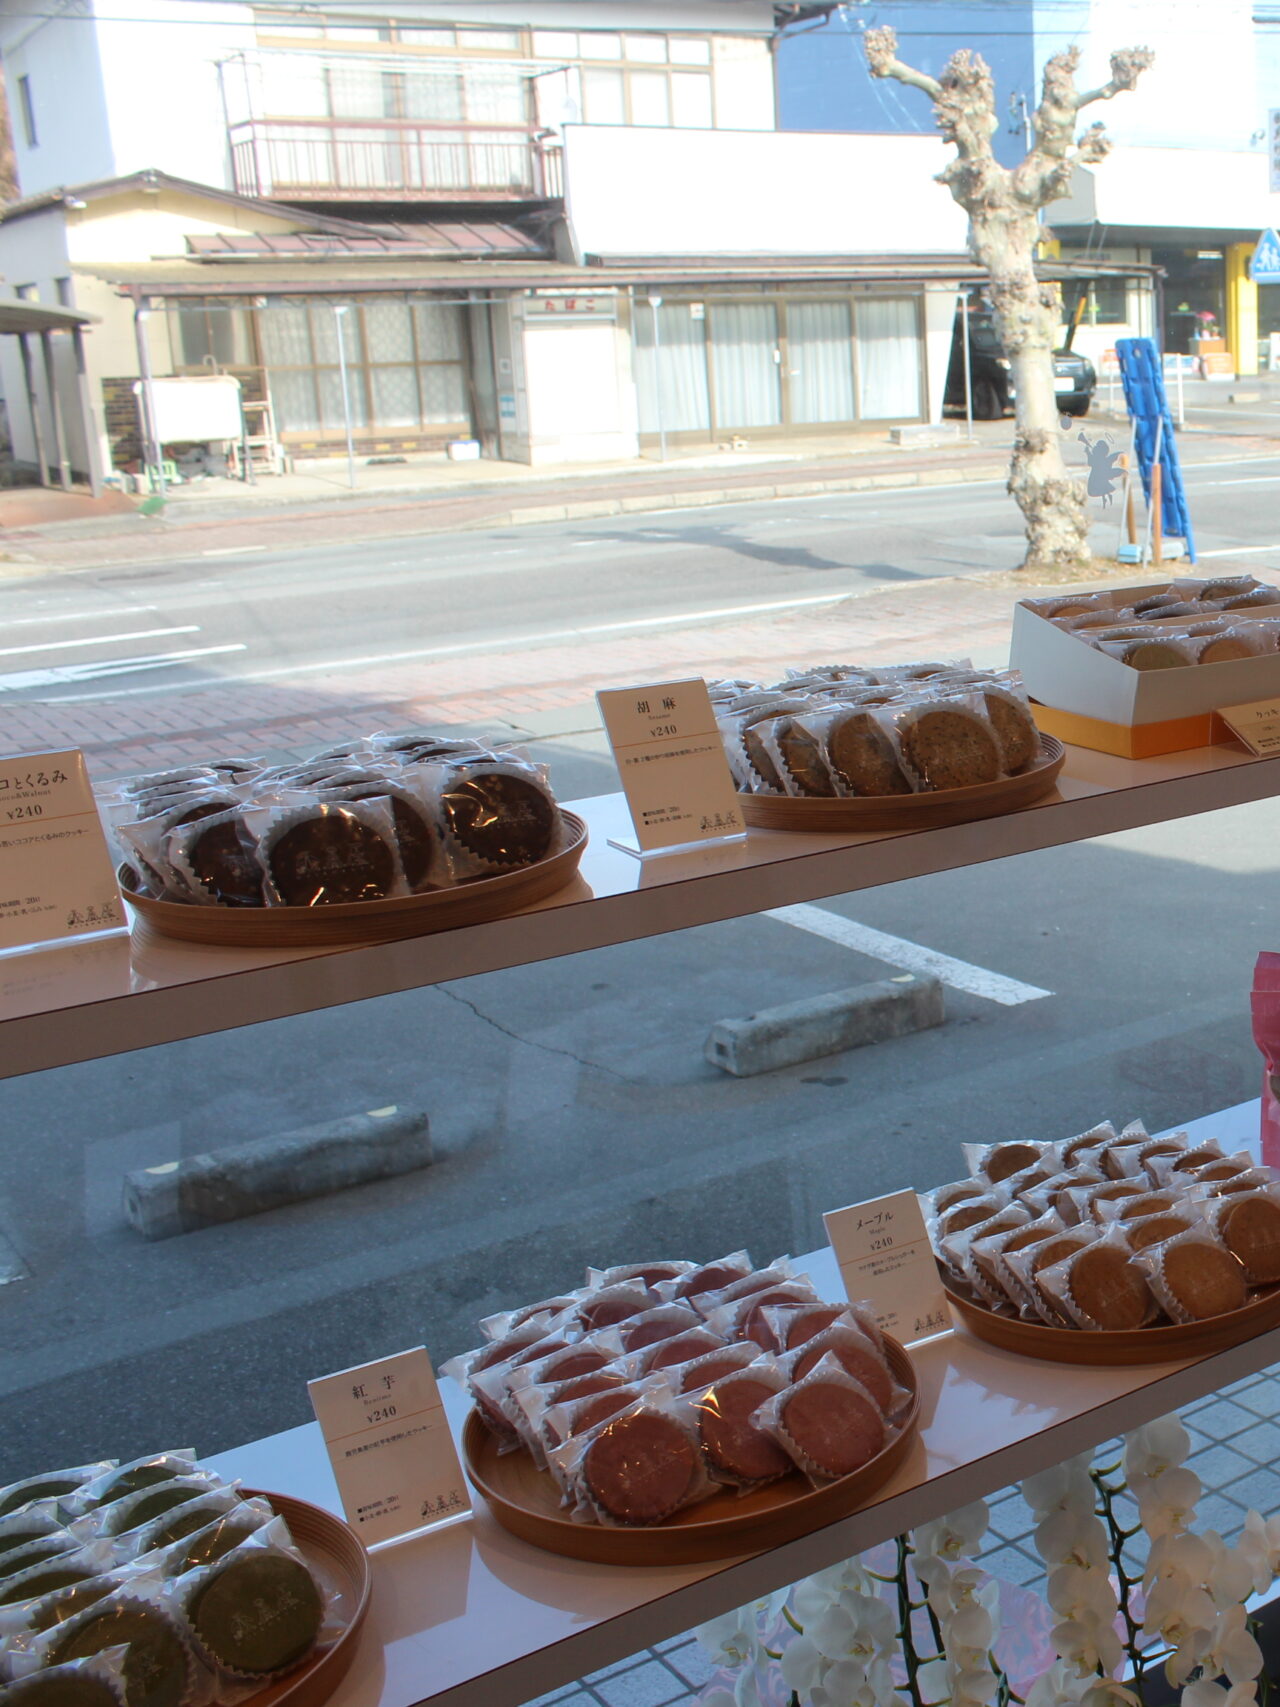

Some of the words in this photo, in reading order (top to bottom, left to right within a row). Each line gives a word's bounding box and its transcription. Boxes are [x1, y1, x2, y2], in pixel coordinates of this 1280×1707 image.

[544, 298, 597, 313] たばこ
[650, 725, 677, 738] ¥240
[7, 804, 43, 820] ¥240
[855, 1211, 894, 1232] メープル
[870, 1237, 893, 1251] ¥240
[352, 1375, 396, 1400] 紅芋
[367, 1405, 397, 1423] ¥240
